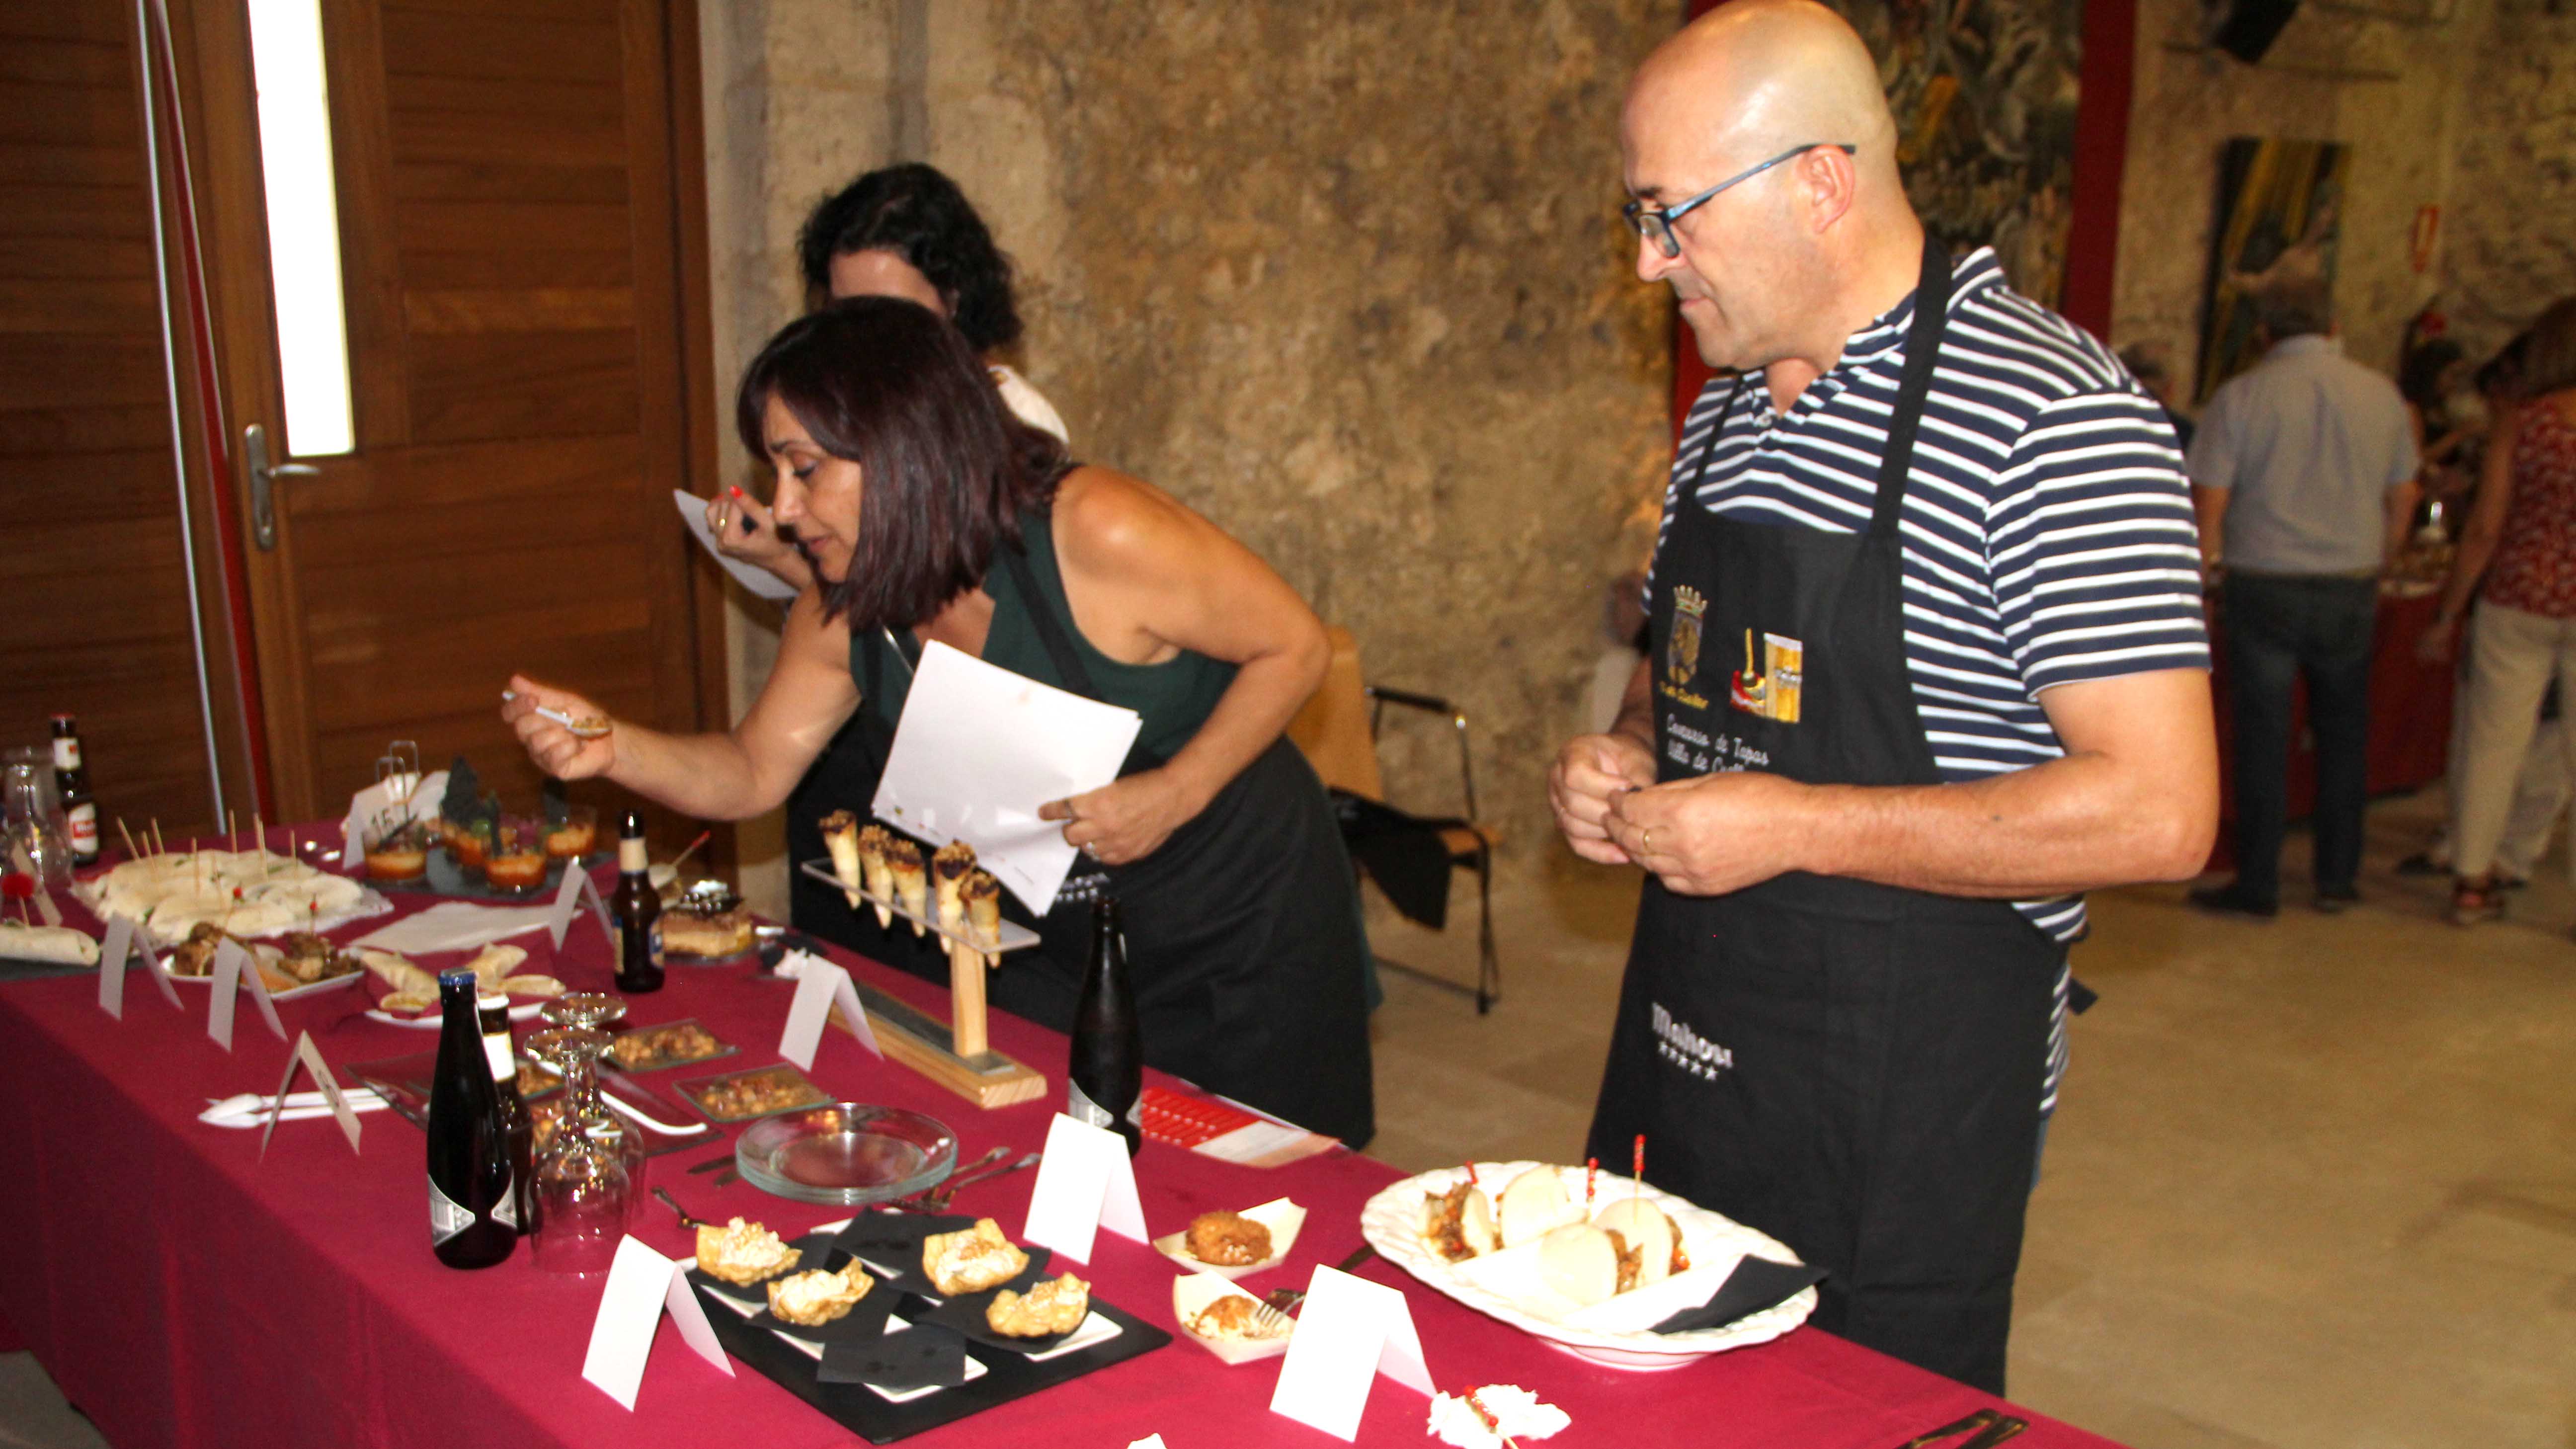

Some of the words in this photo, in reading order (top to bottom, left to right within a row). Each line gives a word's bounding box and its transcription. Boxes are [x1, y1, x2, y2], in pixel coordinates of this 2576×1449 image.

[1668, 738, 1690, 765] Villa
[1692, 751, 1709, 772] de
[1714, 733, 1729, 754] de
[1734, 737, 1770, 767] Tapas
[1652, 1001, 1733, 1068] Mahou
